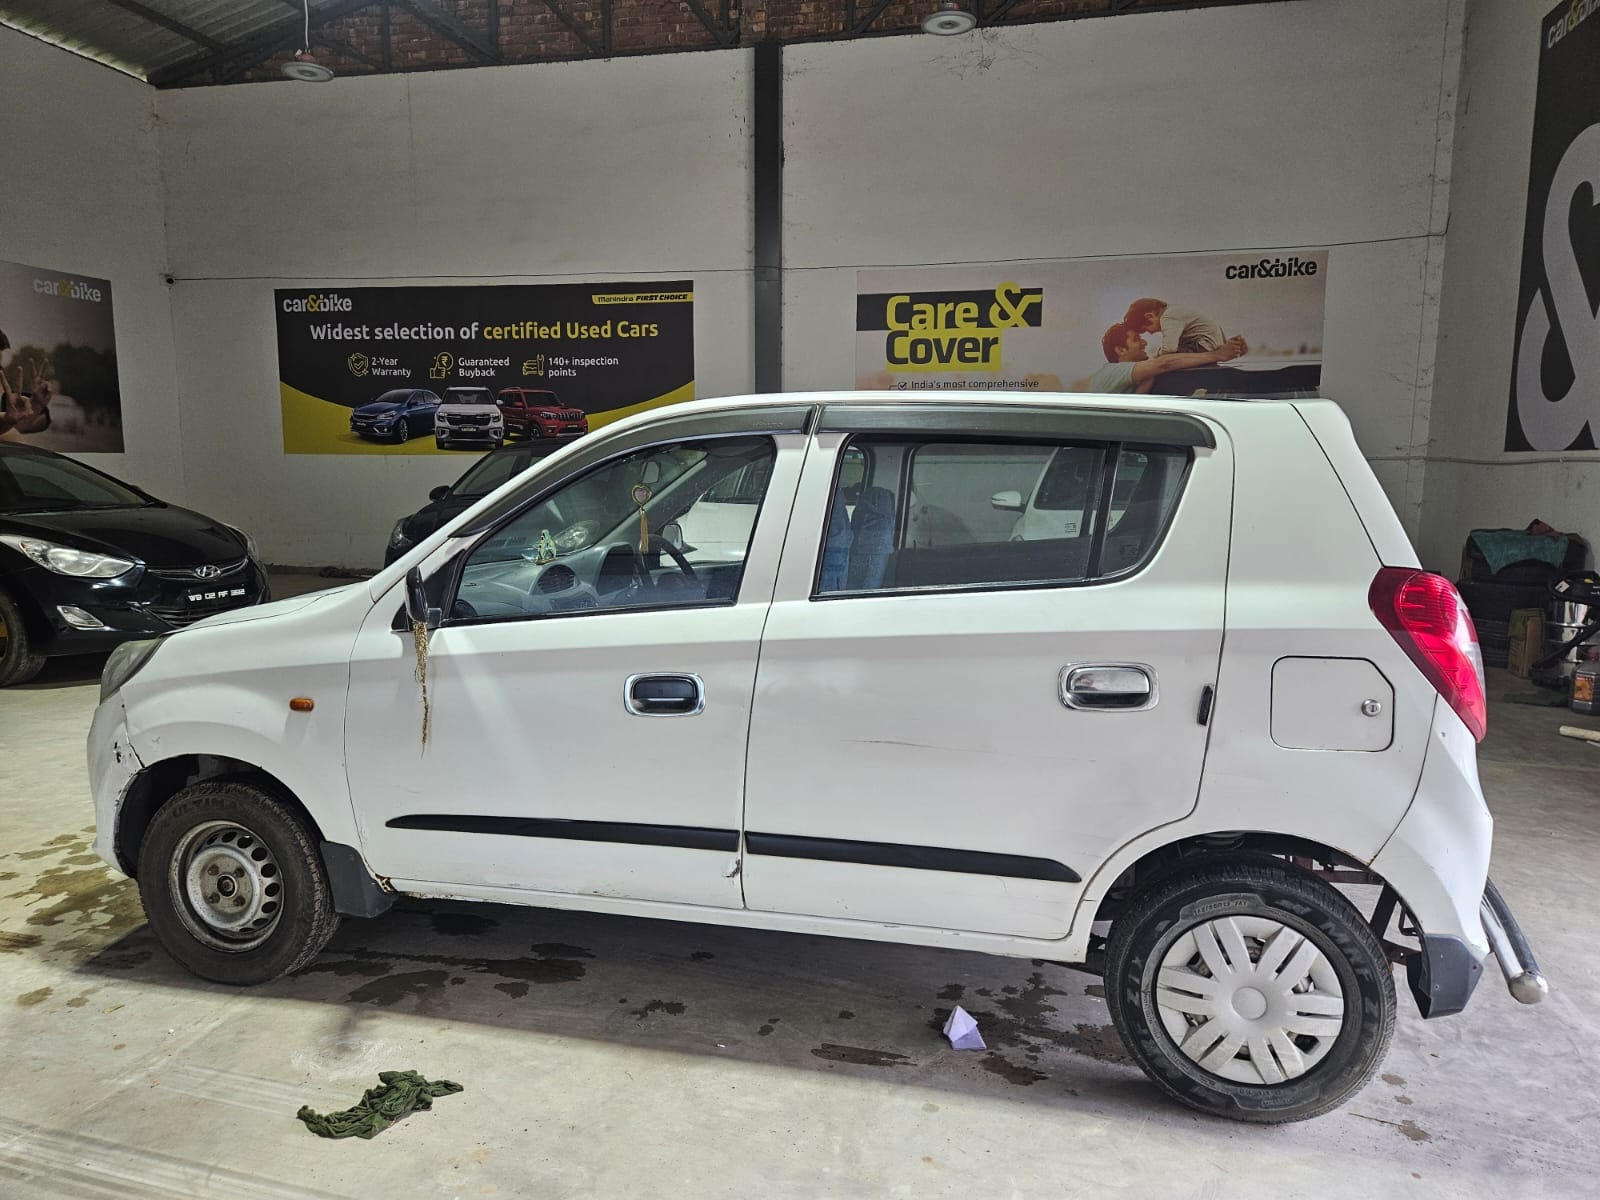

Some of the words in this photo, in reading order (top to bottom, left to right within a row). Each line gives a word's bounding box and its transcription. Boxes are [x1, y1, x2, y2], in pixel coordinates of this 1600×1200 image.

[1225, 257, 1318, 280] car&bike
[283, 294, 352, 312] car&bike
[635, 294, 659, 302] FIRST
[659, 293, 688, 301] CHOICE
[886, 295, 979, 331] Care
[988, 281, 1043, 329] &
[310, 323, 370, 340] Widest
[374, 322, 455, 340] selection
[459, 322, 479, 339] of
[483, 321, 561, 339] certified
[566, 320, 612, 339] Used
[616, 321, 659, 338] Cars
[886, 330, 999, 365] Cover
[371, 357, 399, 366] 2-Year
[458, 357, 510, 366] Guaranteed
[548, 357, 570, 366] 140+
[571, 357, 619, 368] inspection
[371, 368, 412, 378] Warranty
[458, 368, 496, 379] Buyback
[548, 368, 577, 379] points
[911, 380, 941, 389] India's
[943, 380, 967, 389] most
[968, 378, 1039, 390] comprehensive
